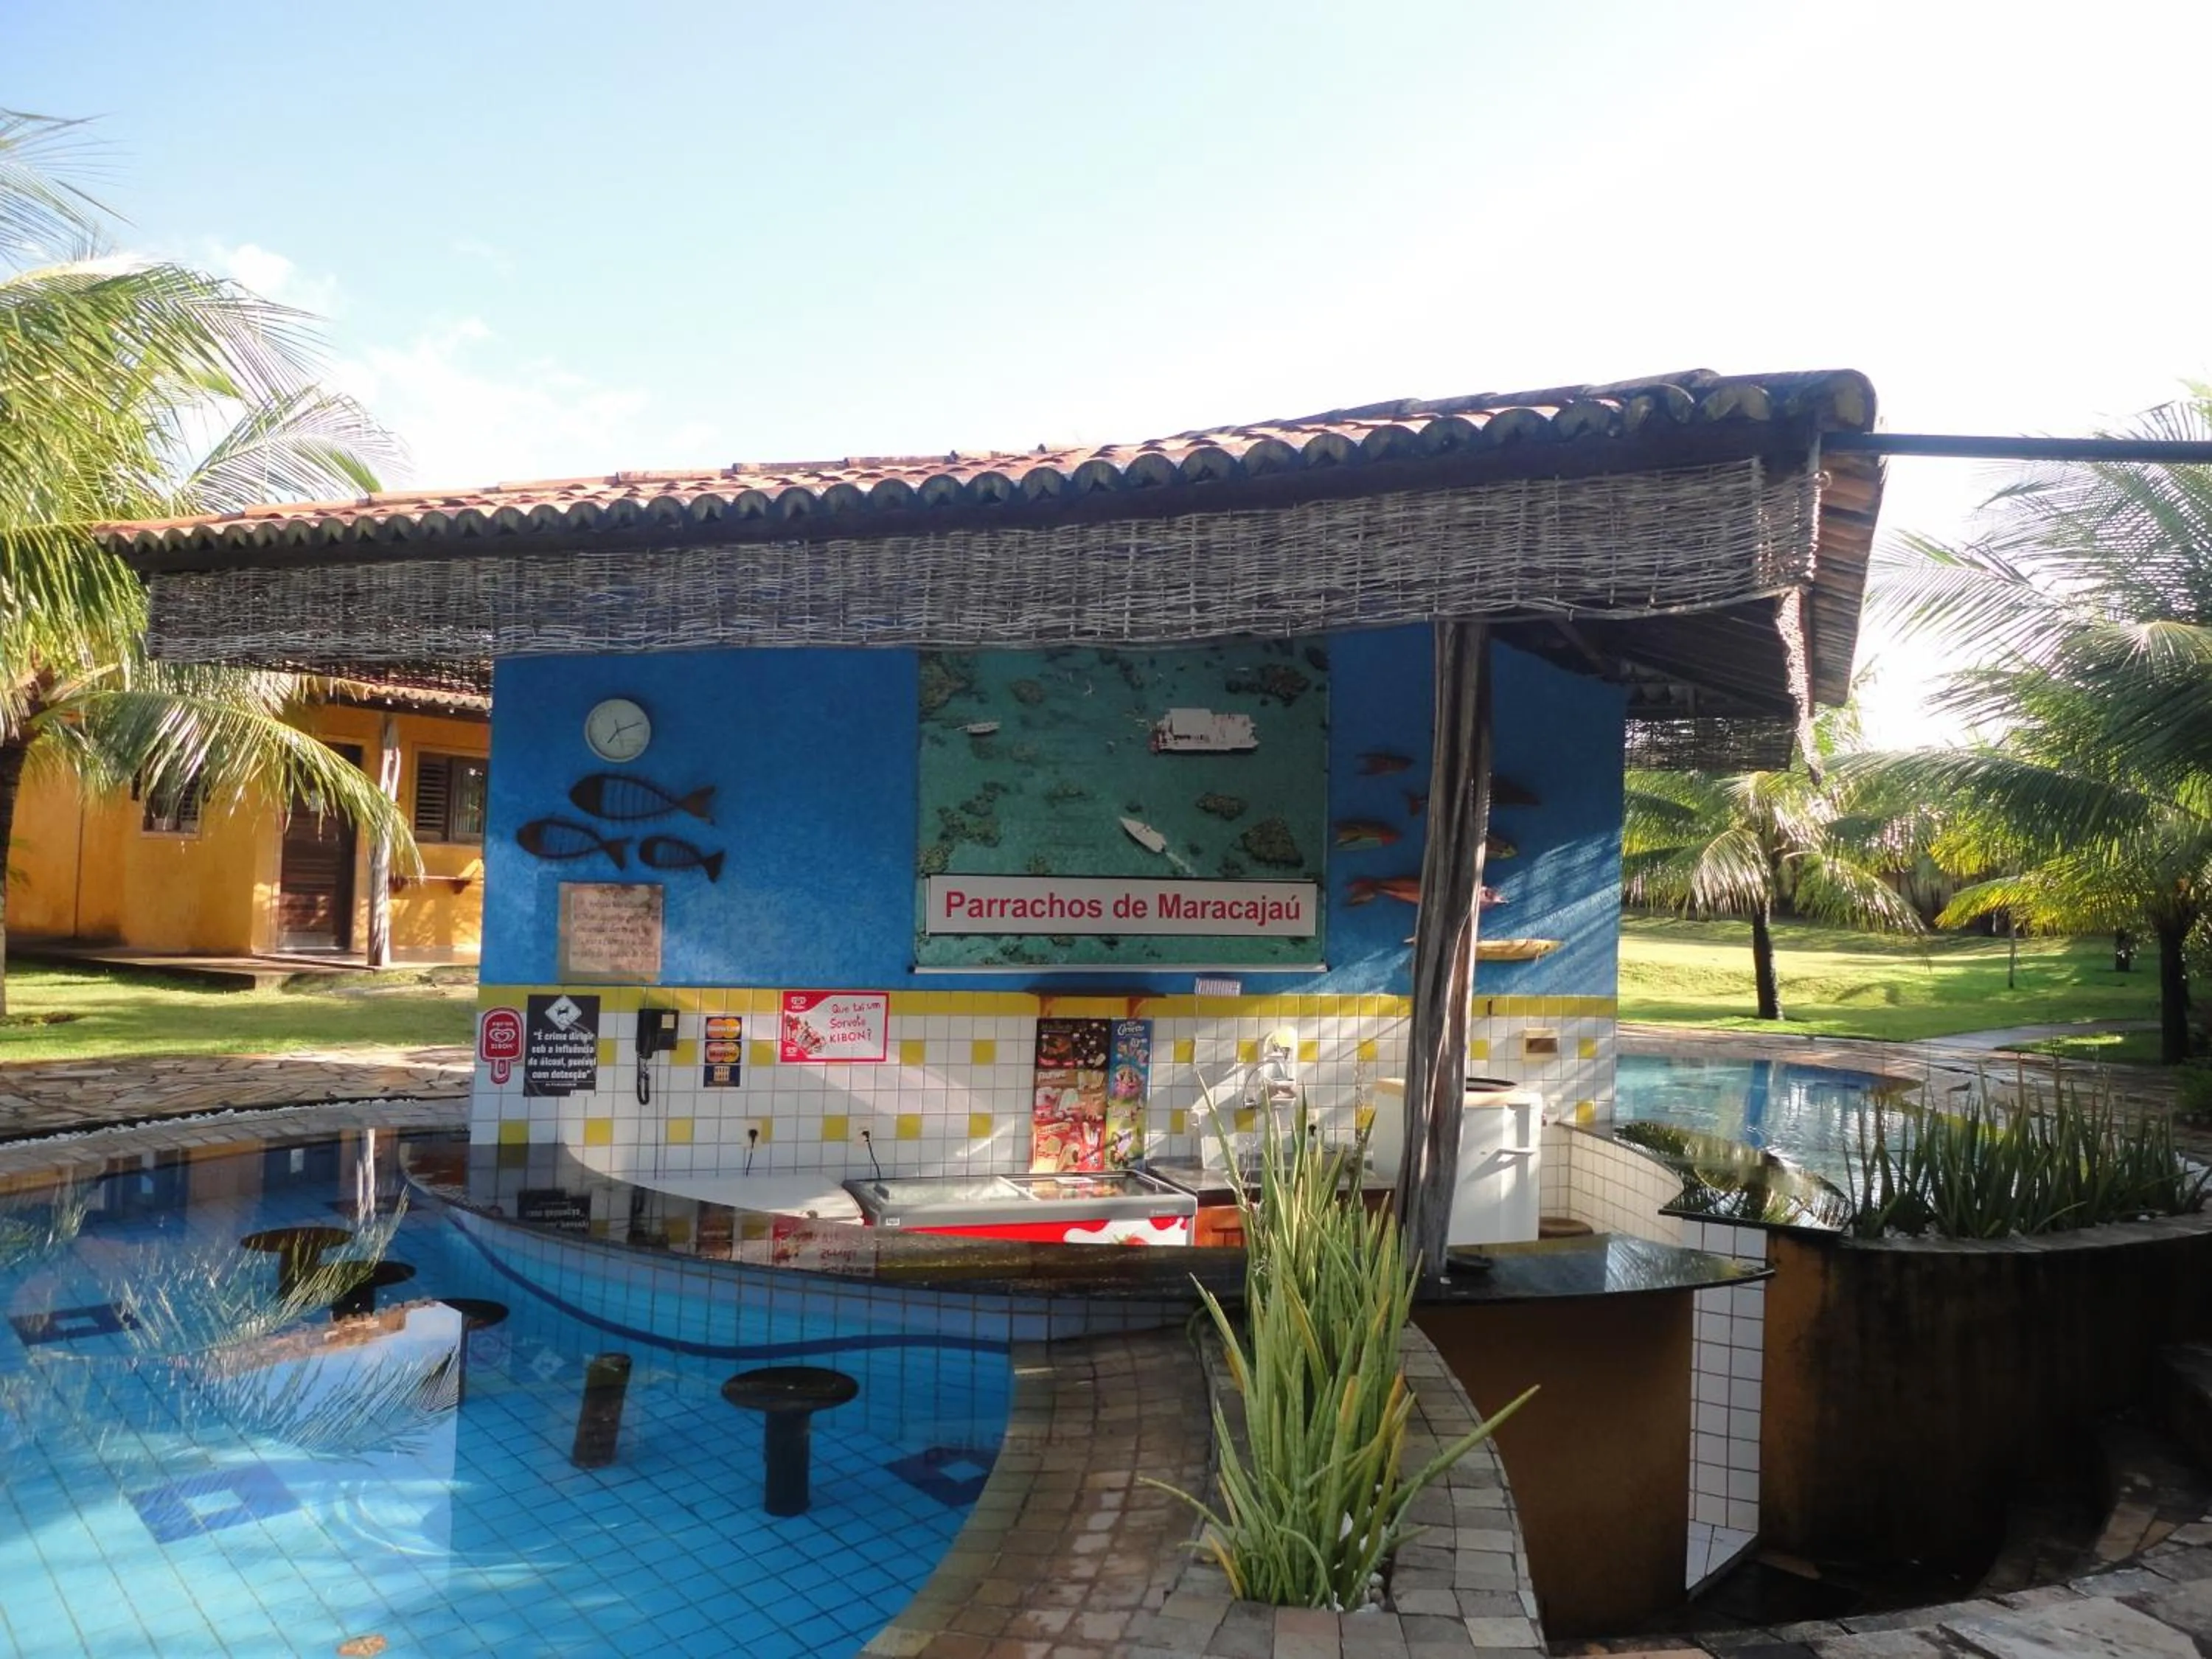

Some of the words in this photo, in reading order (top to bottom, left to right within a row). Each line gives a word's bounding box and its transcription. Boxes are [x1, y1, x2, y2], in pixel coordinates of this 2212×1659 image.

[945, 891, 1103, 919] Parrachos
[1113, 893, 1147, 919] de
[1158, 893, 1301, 926] Maracajaú
[544, 1032, 567, 1040] crime
